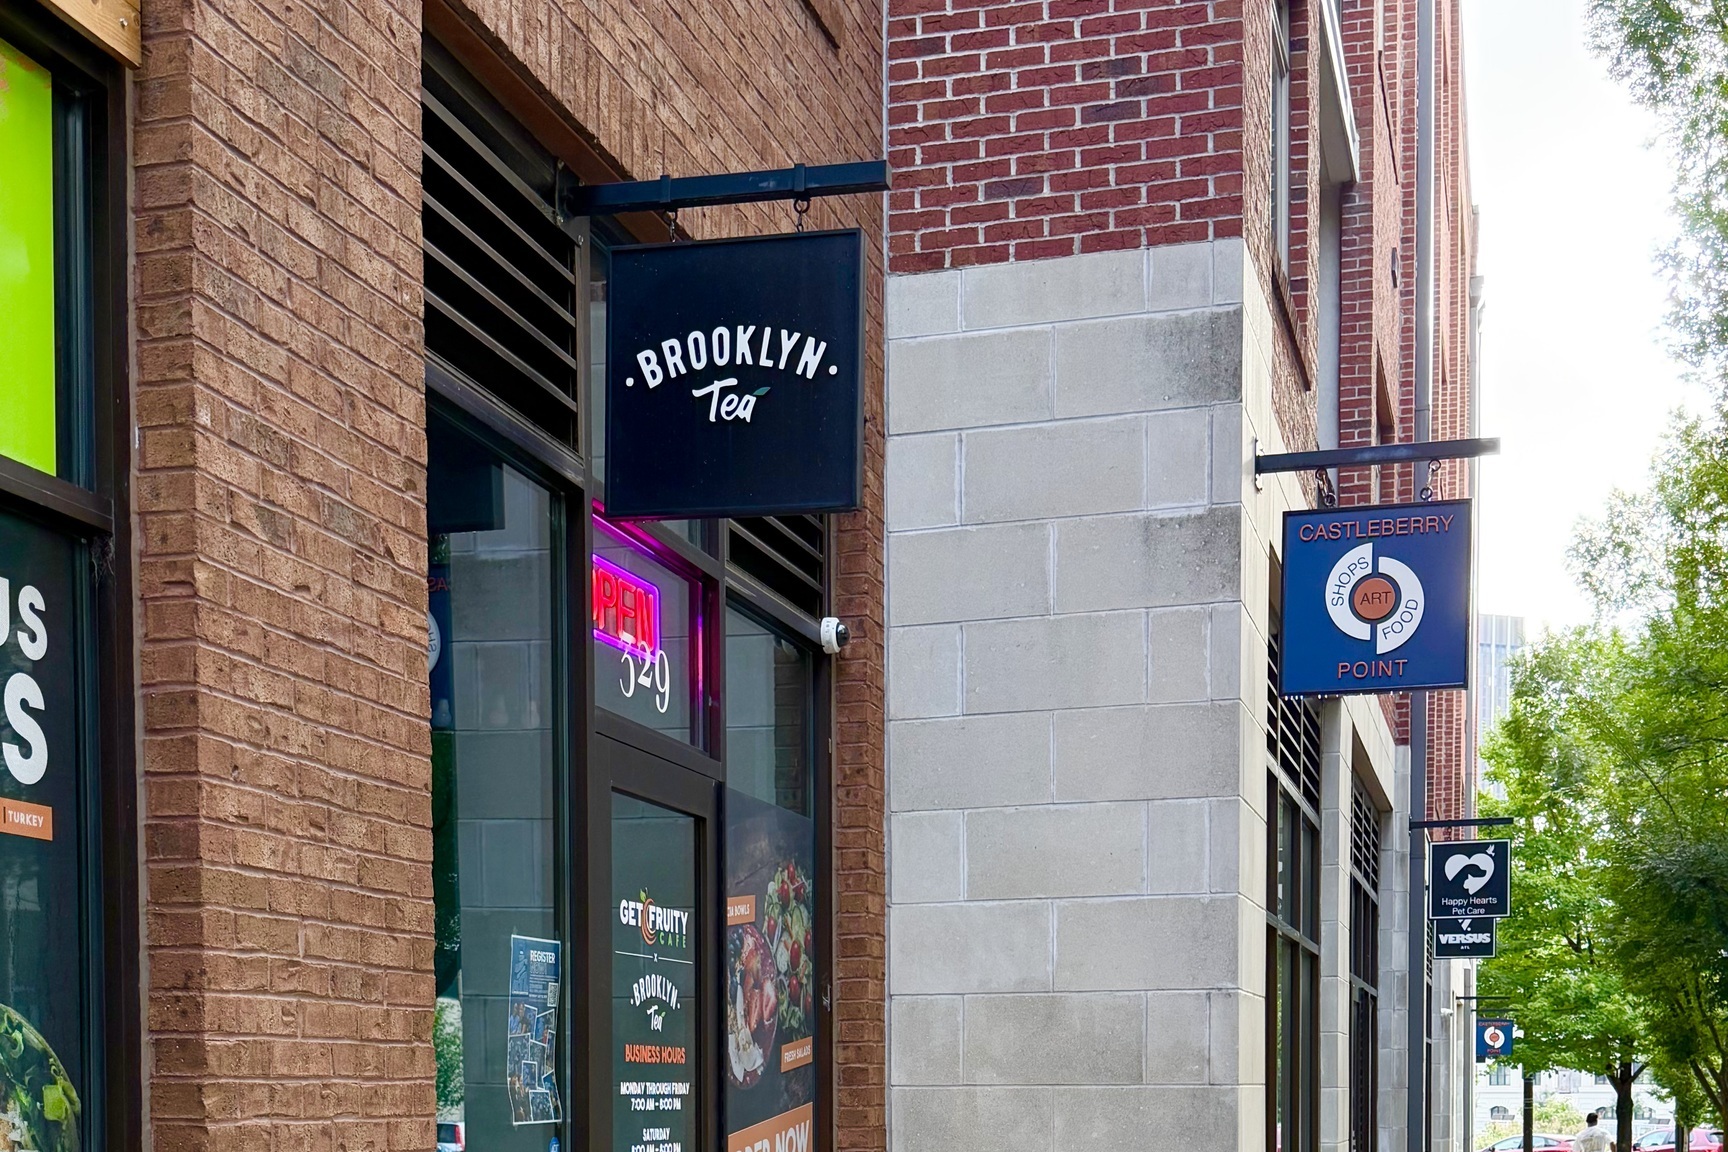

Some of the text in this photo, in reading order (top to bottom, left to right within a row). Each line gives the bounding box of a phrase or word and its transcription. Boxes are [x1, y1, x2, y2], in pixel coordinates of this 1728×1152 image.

[636, 325, 827, 389] BROOKLYN
[692, 378, 757, 423] Tea
[1300, 515, 1454, 541] CASTLEBERRY
[1332, 556, 1369, 607] SHOPS
[1360, 591, 1392, 605] ART
[1382, 599, 1419, 640] FOOD
[619, 631, 670, 713] 529
[1337, 660, 1408, 679] POINT
[8, 809, 44, 828] TURKEY
[1442, 896, 1498, 907] Happy Hearts
[1452, 906, 1485, 915] Pet Care
[620, 899, 688, 935] GET FRUITY
[660, 932, 687, 949] CAFE
[1439, 933, 1491, 944] VERSUS
[530, 950, 556, 964] REGISTER
[633, 974, 679, 1010] BROOKLYN
[647, 1004, 664, 1032] Tea
[625, 1044, 686, 1065] BUSINESS HOURS
[620, 1081, 690, 1095] MONDAY THROUGH FRIDAY
[631, 1097, 646, 1111] 7:00
[646, 1097, 655, 1111] AM
[673, 1097, 681, 1110] PM
[642, 1127, 671, 1141] SATURDAY
